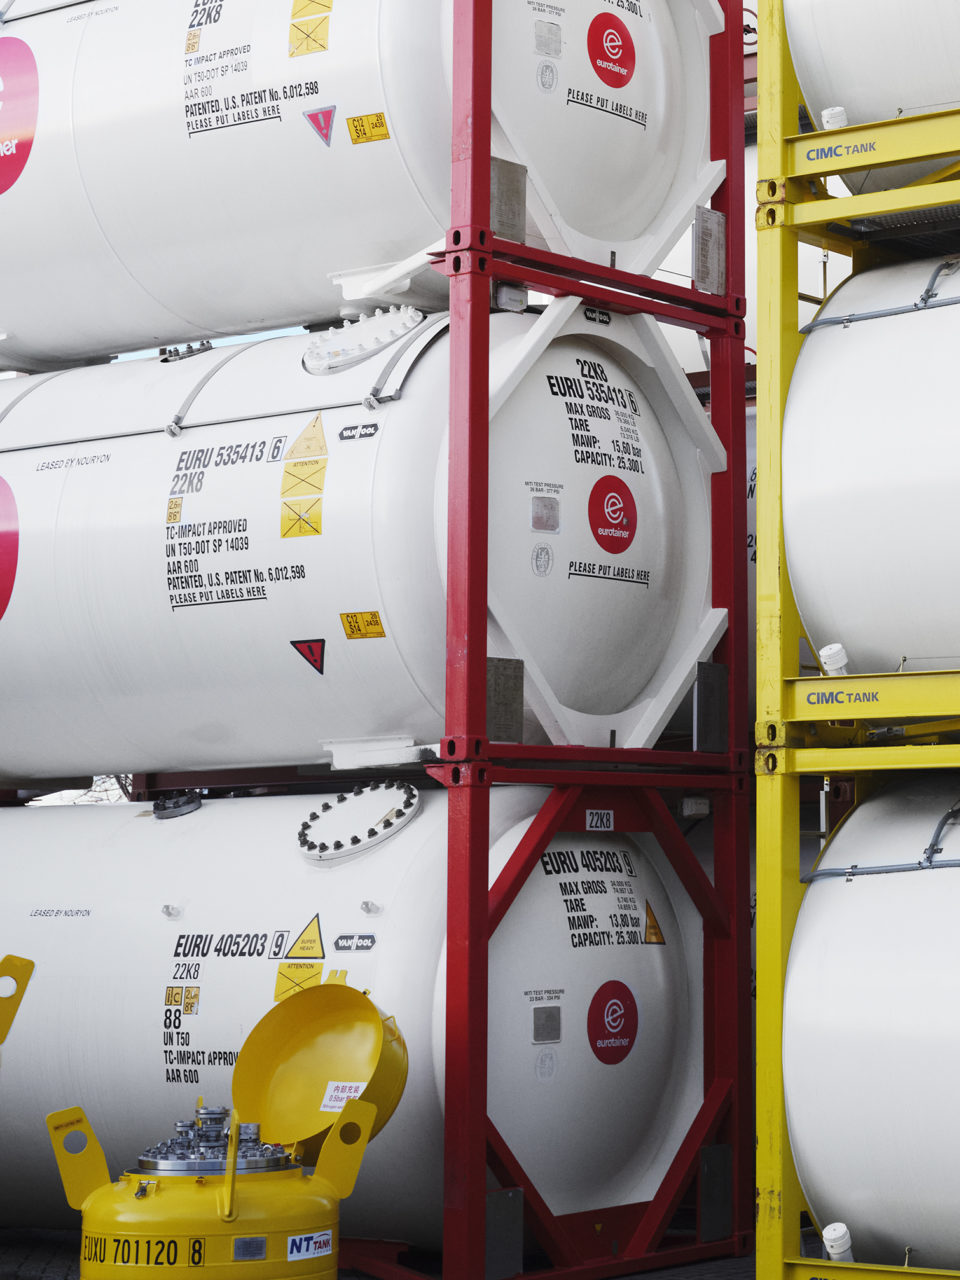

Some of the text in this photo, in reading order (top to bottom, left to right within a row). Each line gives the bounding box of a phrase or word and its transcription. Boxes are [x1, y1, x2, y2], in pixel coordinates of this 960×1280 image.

[188, 4, 222, 29] 22K8
[187, 104, 280, 131] PLEASE PUT LABELS HERE
[806, 142, 876, 161] CIMC TANK
[576, 358, 607, 383] 22K8
[176, 439, 282, 471] EURU 535413 6
[574, 449, 615, 468] CAPACITY:
[170, 471, 204, 495] 22K8
[208, 519, 247, 534] APPROVED
[598, 527, 629, 539] eurotainer
[166, 544, 176, 557] UN
[213, 539, 223, 552] SP
[226, 537, 249, 551] 14039
[167, 559, 199, 575] AAR 600
[569, 561, 649, 581] PLEASE PUT LABELS HERE
[208, 573, 223, 587] U.S.
[225, 569, 252, 585] PATENT
[254, 569, 266, 582] No.
[807, 691, 879, 704] CIMC TANK
[589, 812, 611, 829] 22K8
[540, 850, 623, 876] EURU 405203
[173, 933, 284, 957] EURU 405203 9
[173, 963, 200, 980] 22K8
[164, 1008, 181, 1029] 88
[164, 1032, 189, 1046] UN T50
[166, 1069, 198, 1083] AAR 600
[84, 1235, 202, 1265] EUXU 701120 8
[290, 1236, 330, 1254] NT TANK
